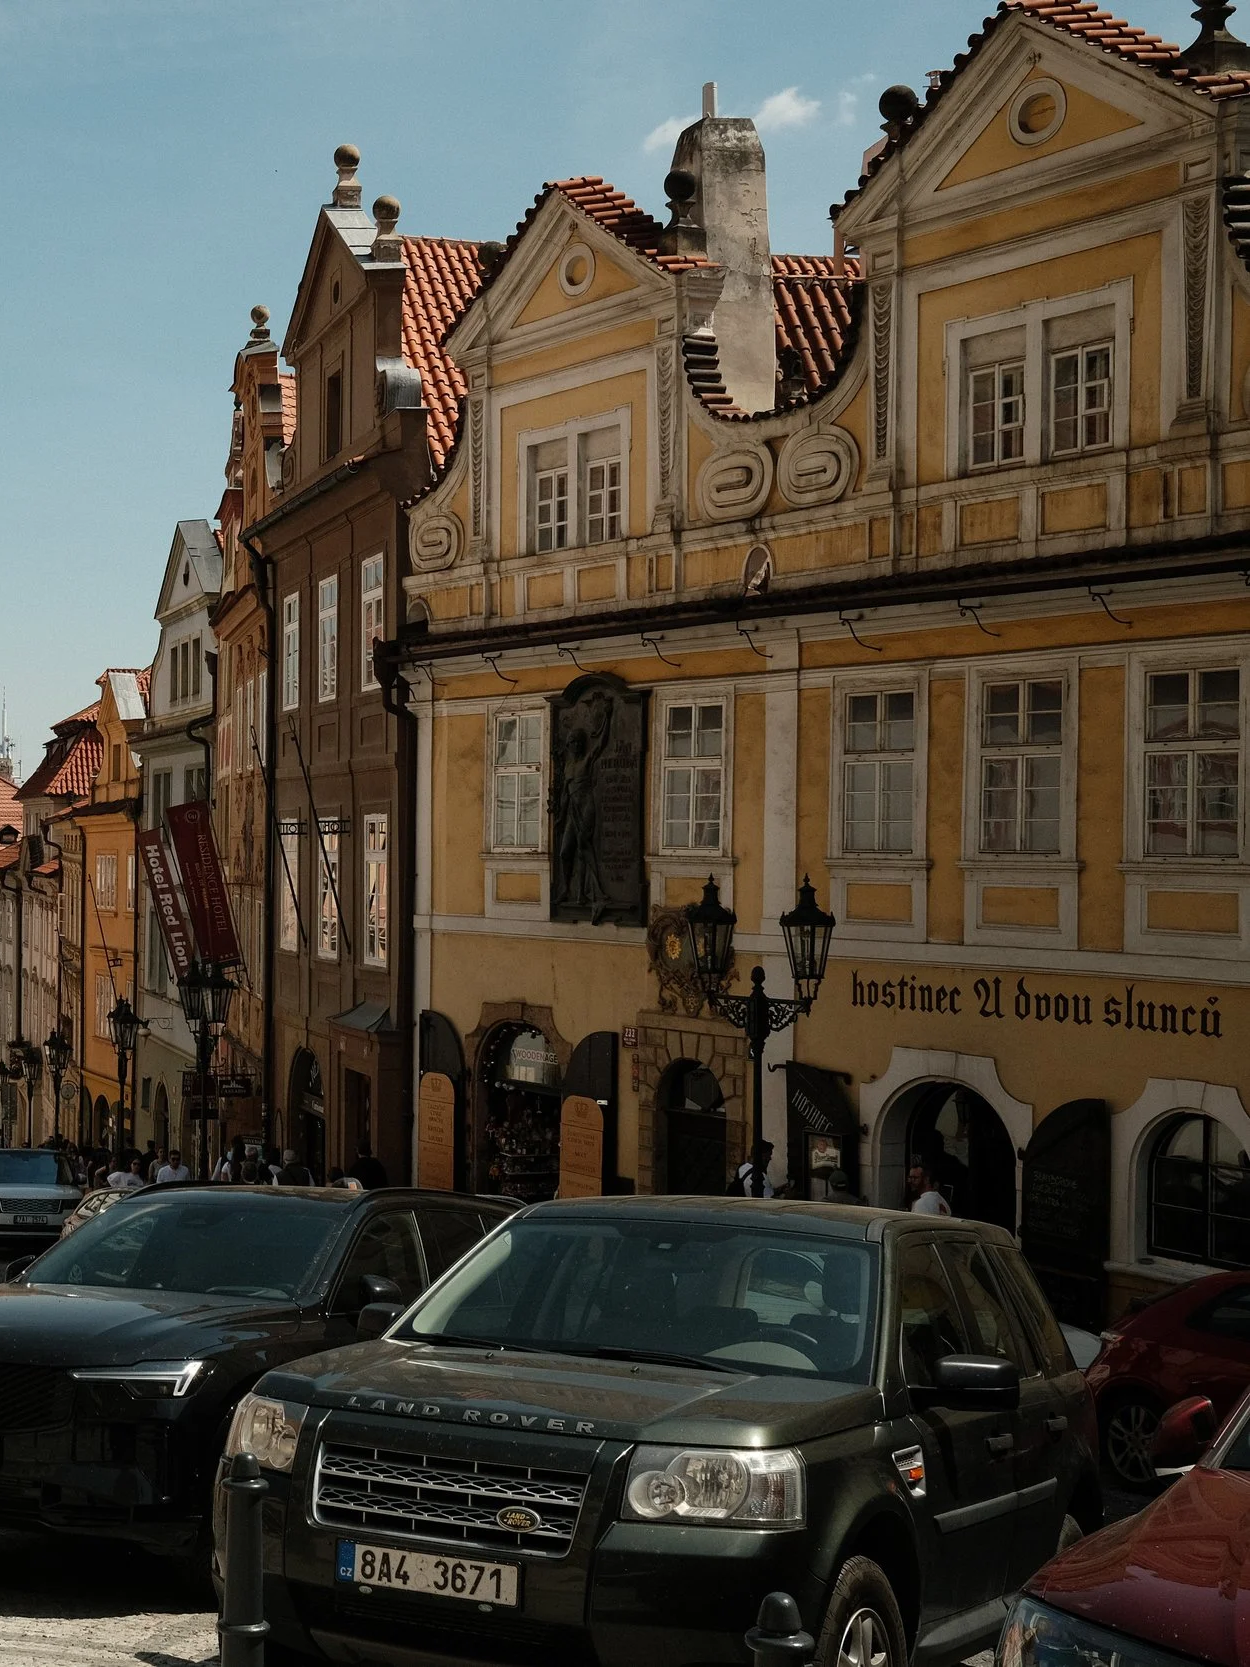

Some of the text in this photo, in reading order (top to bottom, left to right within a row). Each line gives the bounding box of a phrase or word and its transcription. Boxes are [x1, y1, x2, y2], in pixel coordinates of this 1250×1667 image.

[145, 844, 189, 968] Hotel Red Lion
[197, 833, 228, 933] RESIDENCE HOTEL
[852, 970, 963, 1015] hostinec
[1014, 977, 1093, 1025] dvou
[1103, 985, 1223, 1038] slunců
[347, 1396, 596, 1434] LAND ROVER
[340, 1566, 352, 1577] CZ
[360, 1549, 502, 1599] 8A4 3671
